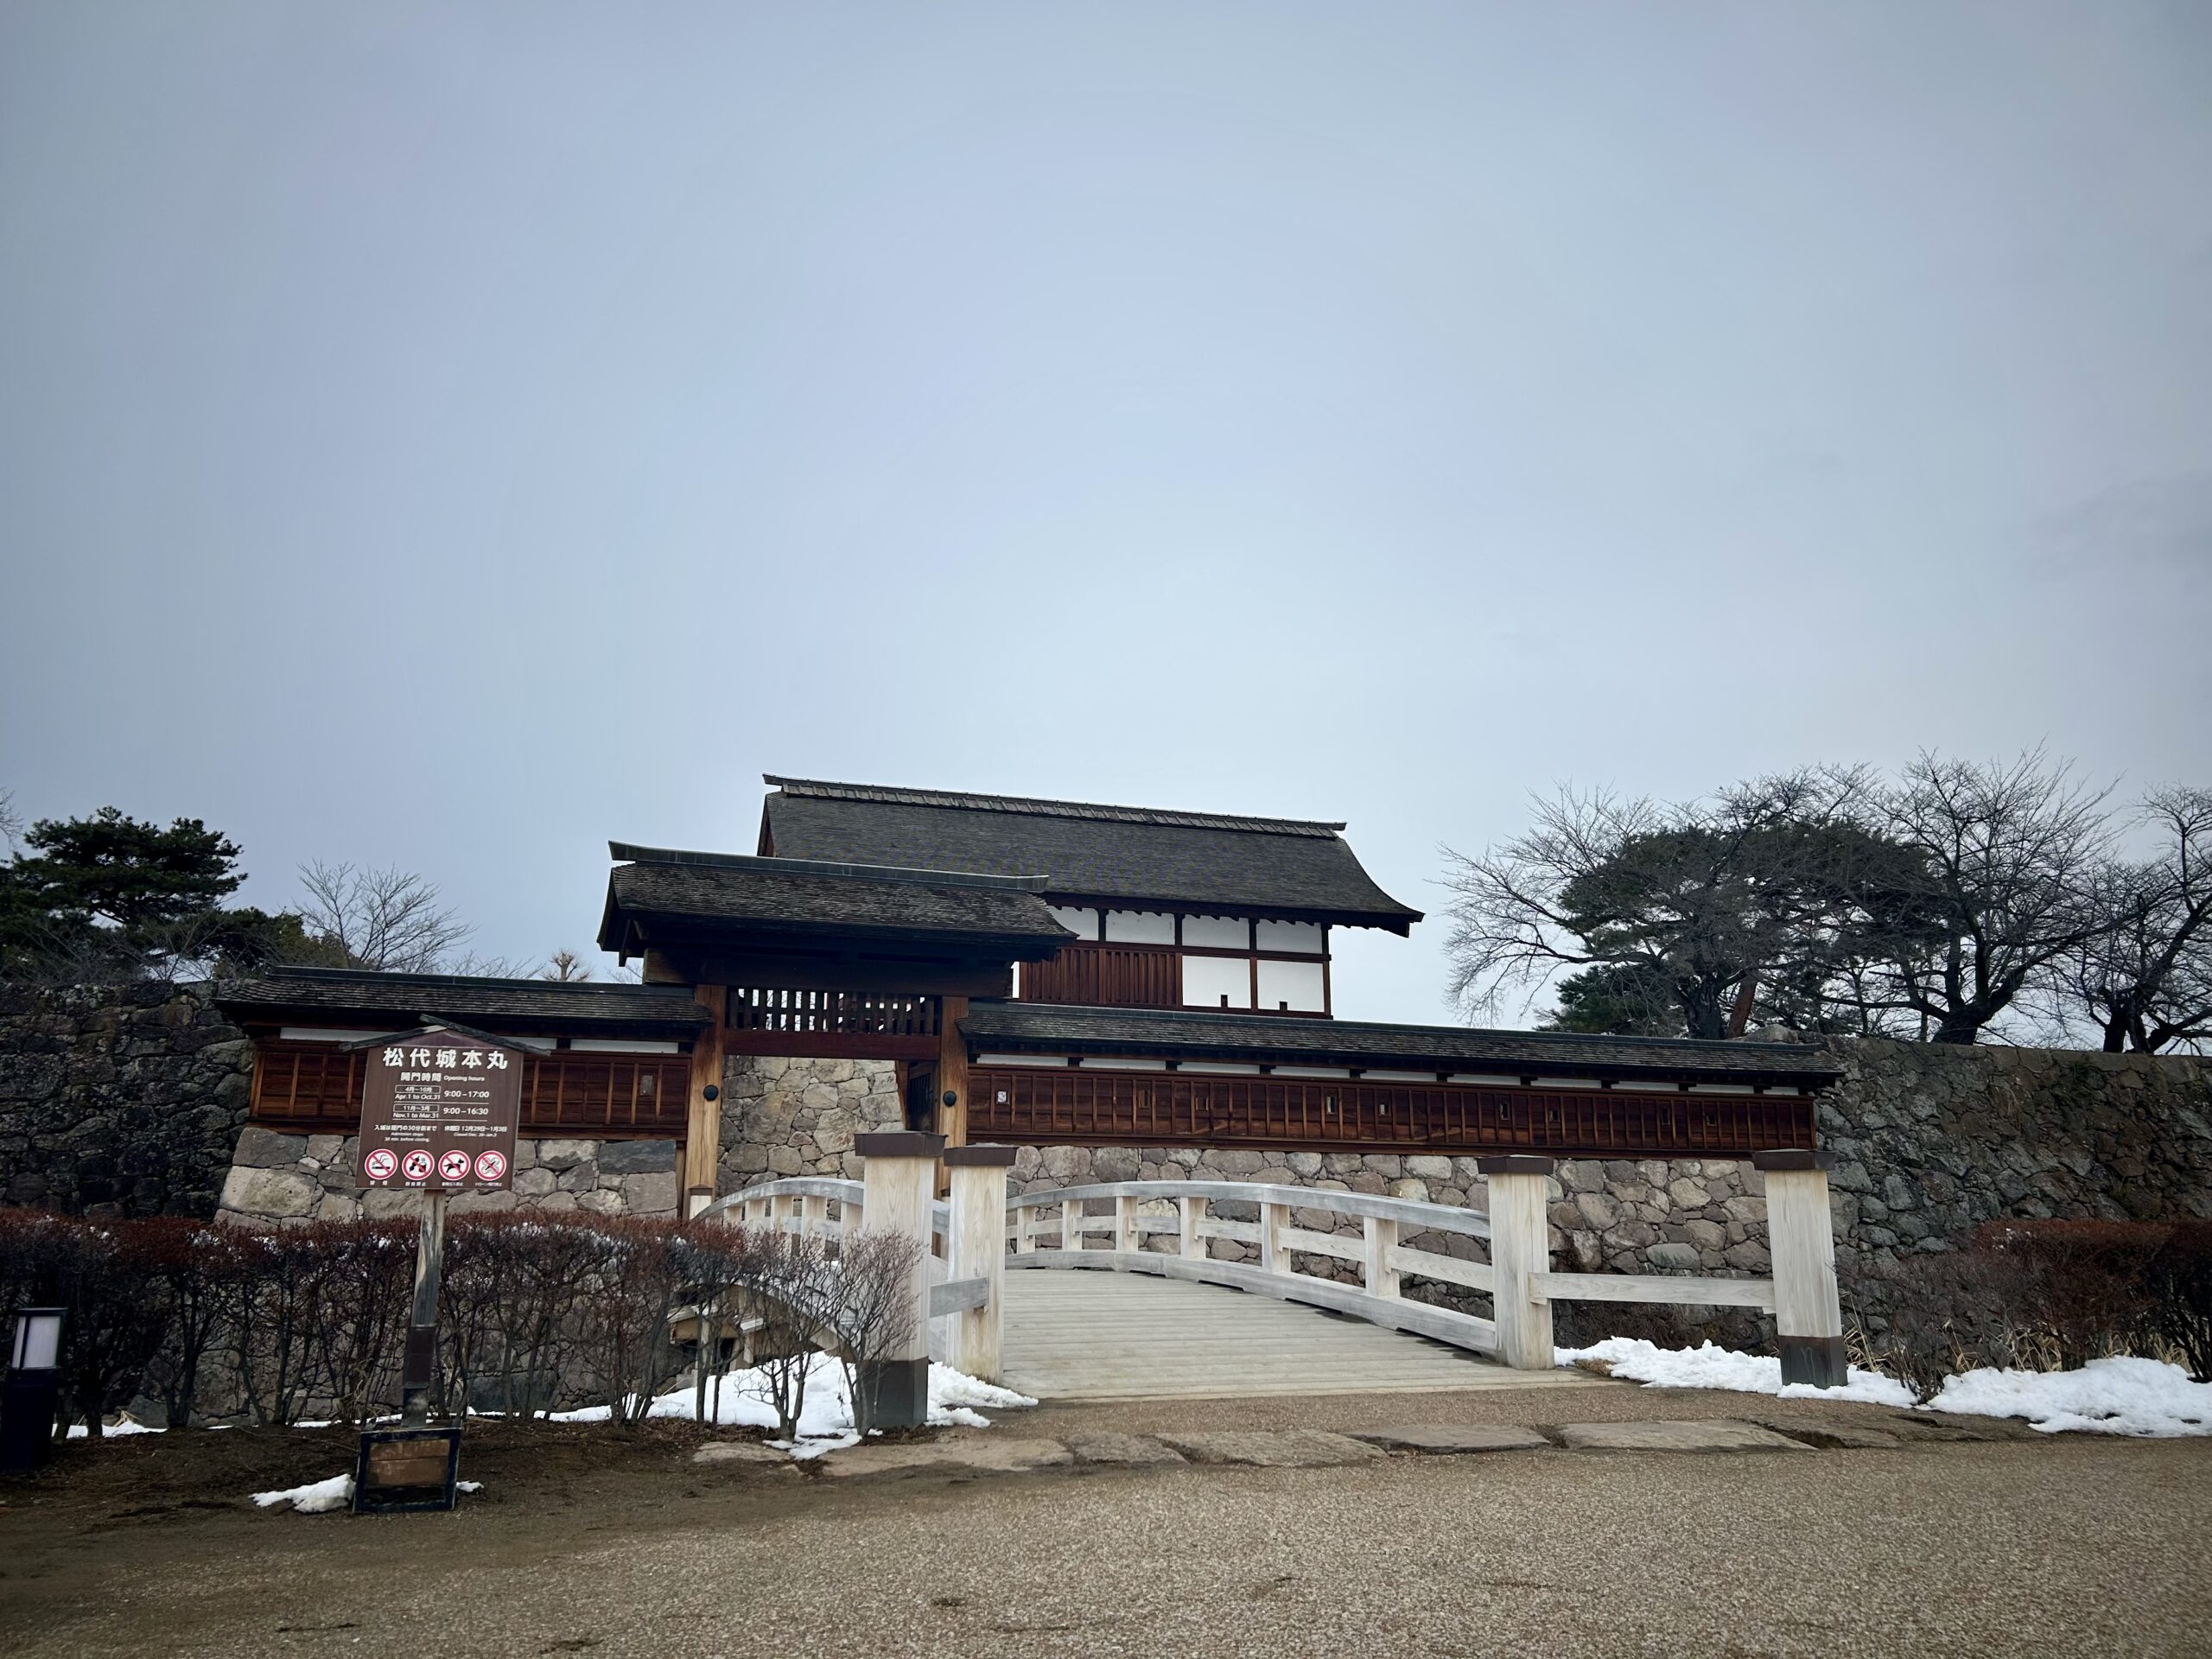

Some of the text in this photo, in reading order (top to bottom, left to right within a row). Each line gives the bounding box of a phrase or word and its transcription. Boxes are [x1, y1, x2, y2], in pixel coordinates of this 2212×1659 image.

[383, 1047, 507, 1070] 松代城本丸
[400, 1072, 442, 1082] 開門時間
